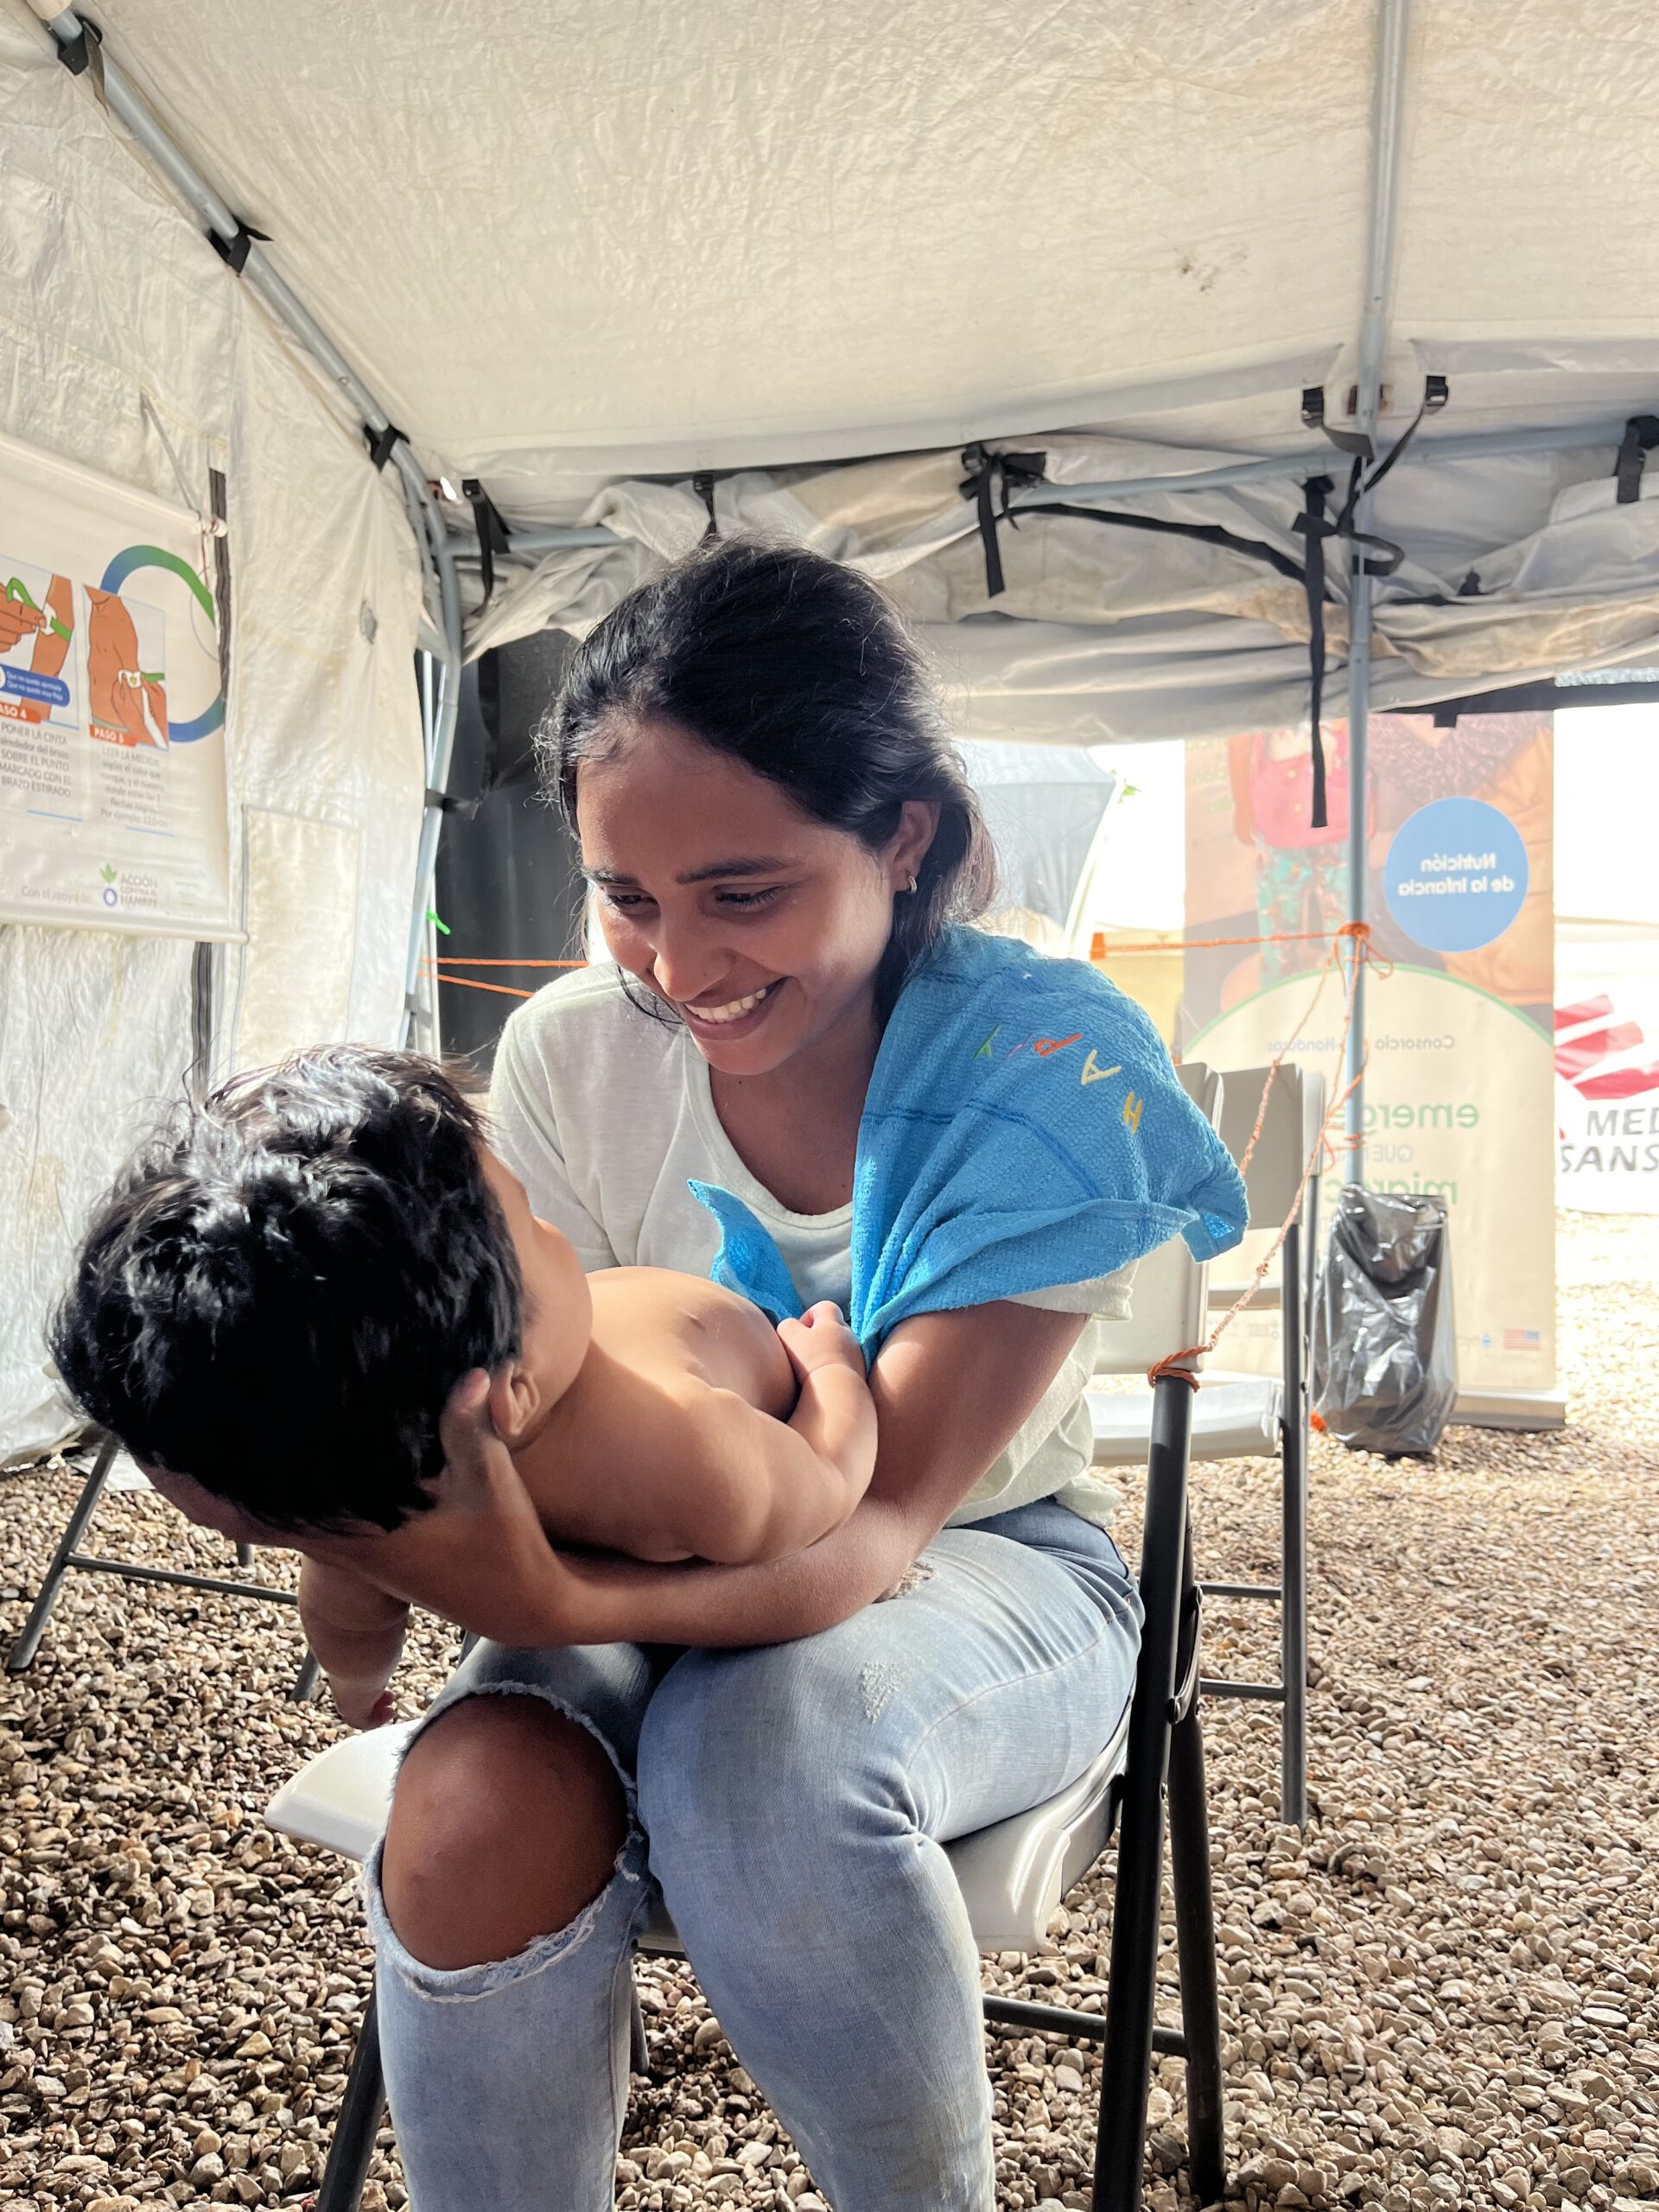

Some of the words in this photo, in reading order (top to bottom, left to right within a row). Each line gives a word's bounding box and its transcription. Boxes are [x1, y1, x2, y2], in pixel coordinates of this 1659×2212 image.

[0, 702, 18, 718] ASO
[20, 709, 28, 720] 4
[1, 722, 30, 738] PONER
[31, 729, 41, 741] LA
[43, 732, 67, 745] CINTA
[93, 727, 118, 743] PASO
[1, 748, 28, 764] SOBRE
[30, 755, 40, 766] EL
[41, 757, 70, 772] PUNTO
[36, 745, 48, 755] del
[49, 747, 69, 760] brazo
[0, 761, 41, 779] MARCADO
[43, 771, 62, 785] CON
[64, 776, 73, 786] EL
[1, 776, 29, 790] BRAZO
[31, 781, 71, 798] ESTIRADO
[21, 886, 41, 899] Con
[41, 888, 51, 899] el
[1560, 1143, 1659, 1173] SANS
